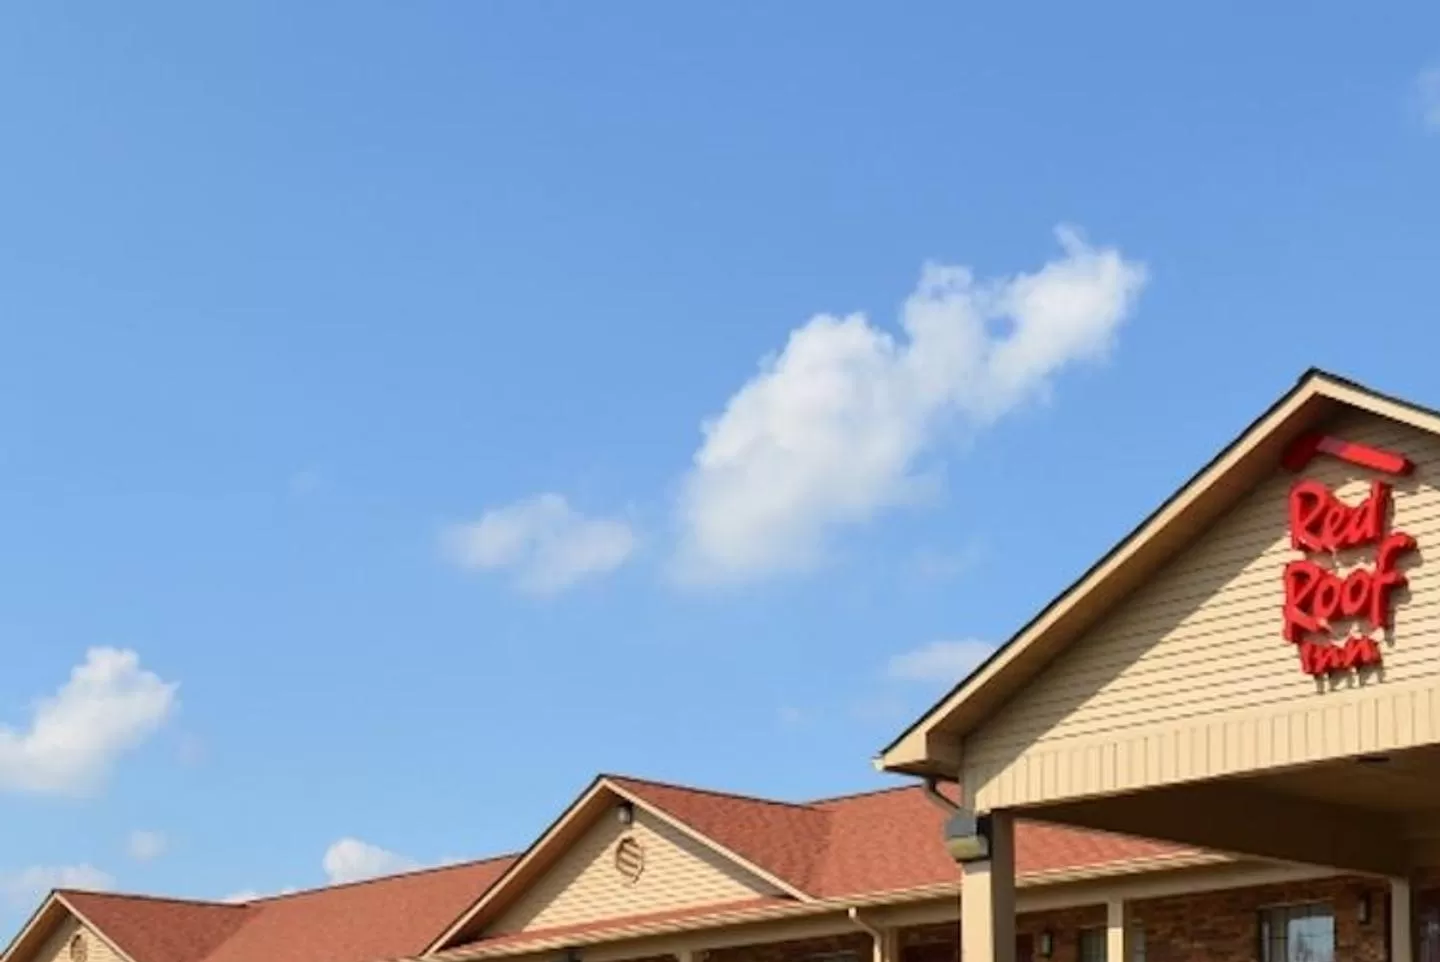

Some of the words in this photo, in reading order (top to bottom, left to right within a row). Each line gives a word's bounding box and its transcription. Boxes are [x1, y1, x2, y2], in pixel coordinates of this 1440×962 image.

[1289, 478, 1390, 553] Red
[1283, 532, 1417, 643] Roof
[1299, 635, 1382, 675] Inn
